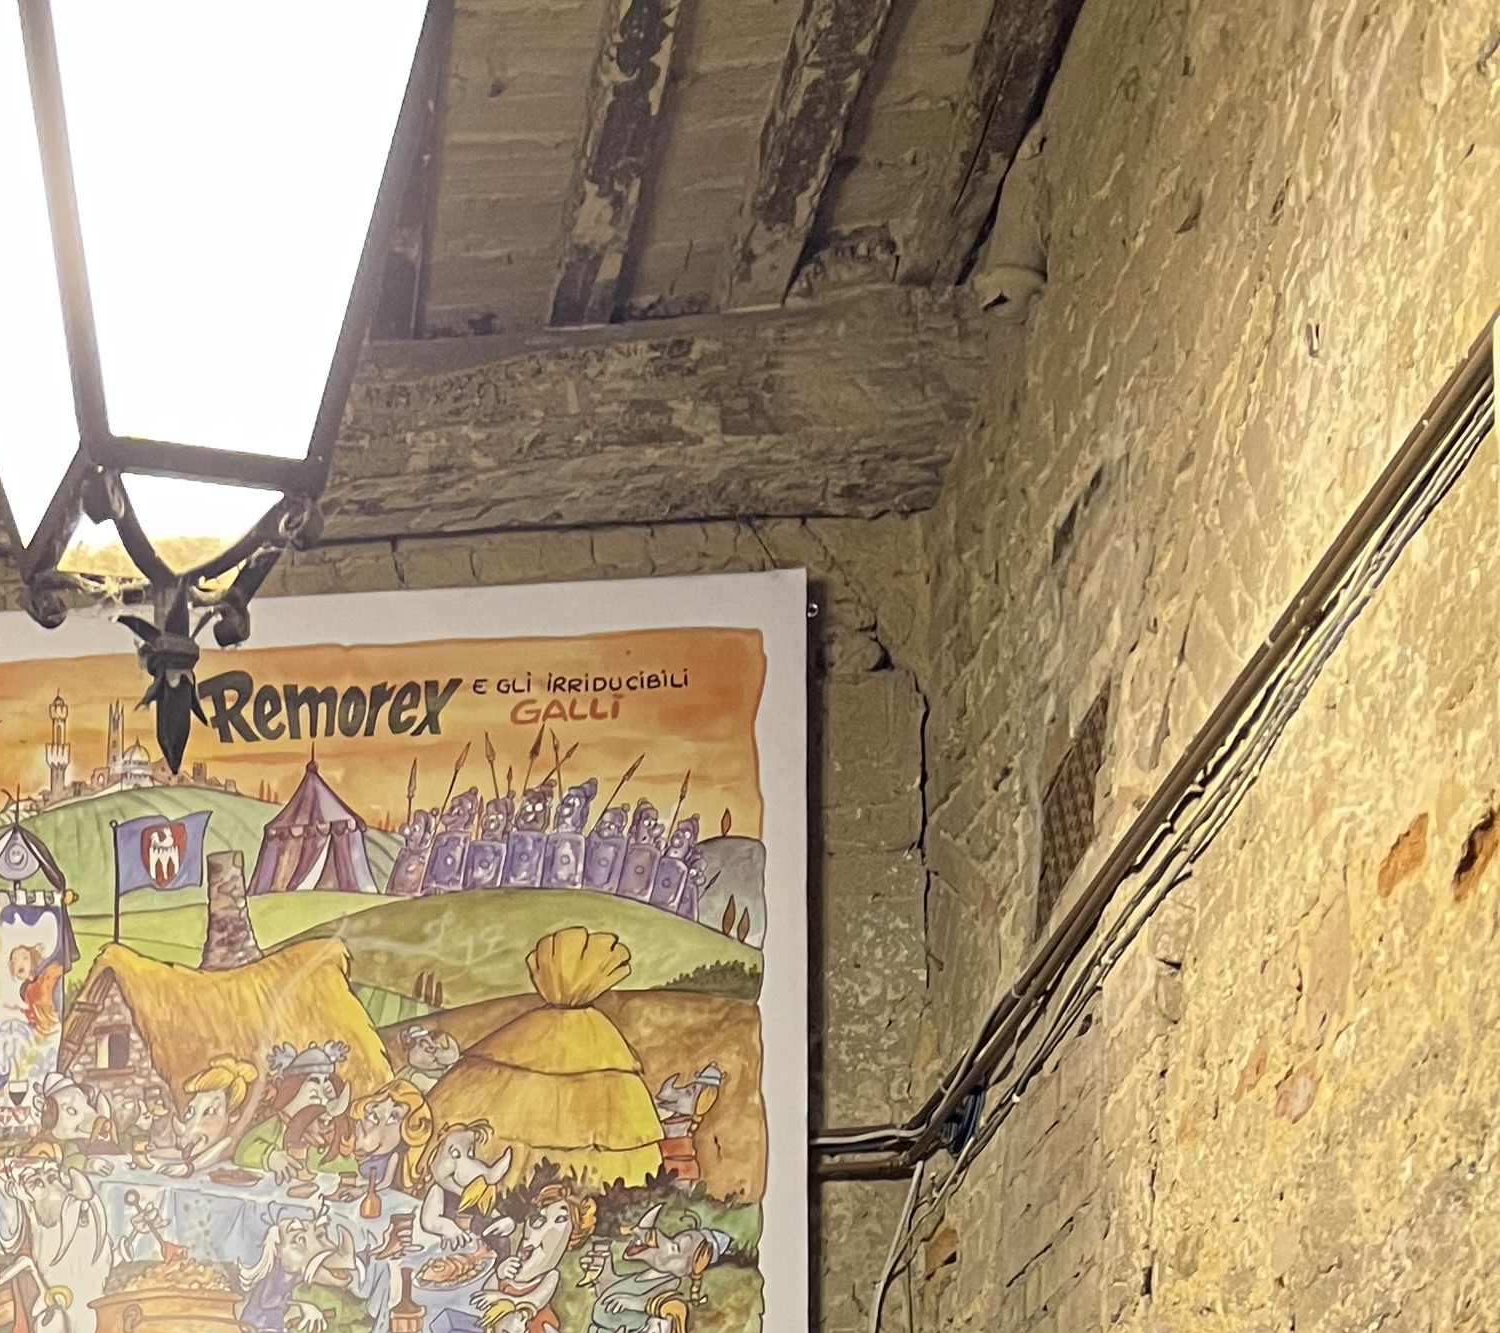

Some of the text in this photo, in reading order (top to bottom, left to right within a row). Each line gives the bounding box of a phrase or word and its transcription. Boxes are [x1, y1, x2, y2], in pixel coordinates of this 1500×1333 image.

[198, 670, 463, 743] Remorex
[472, 678, 488, 695] E
[496, 671, 532, 694] GLI
[510, 694, 624, 725] GALLI
